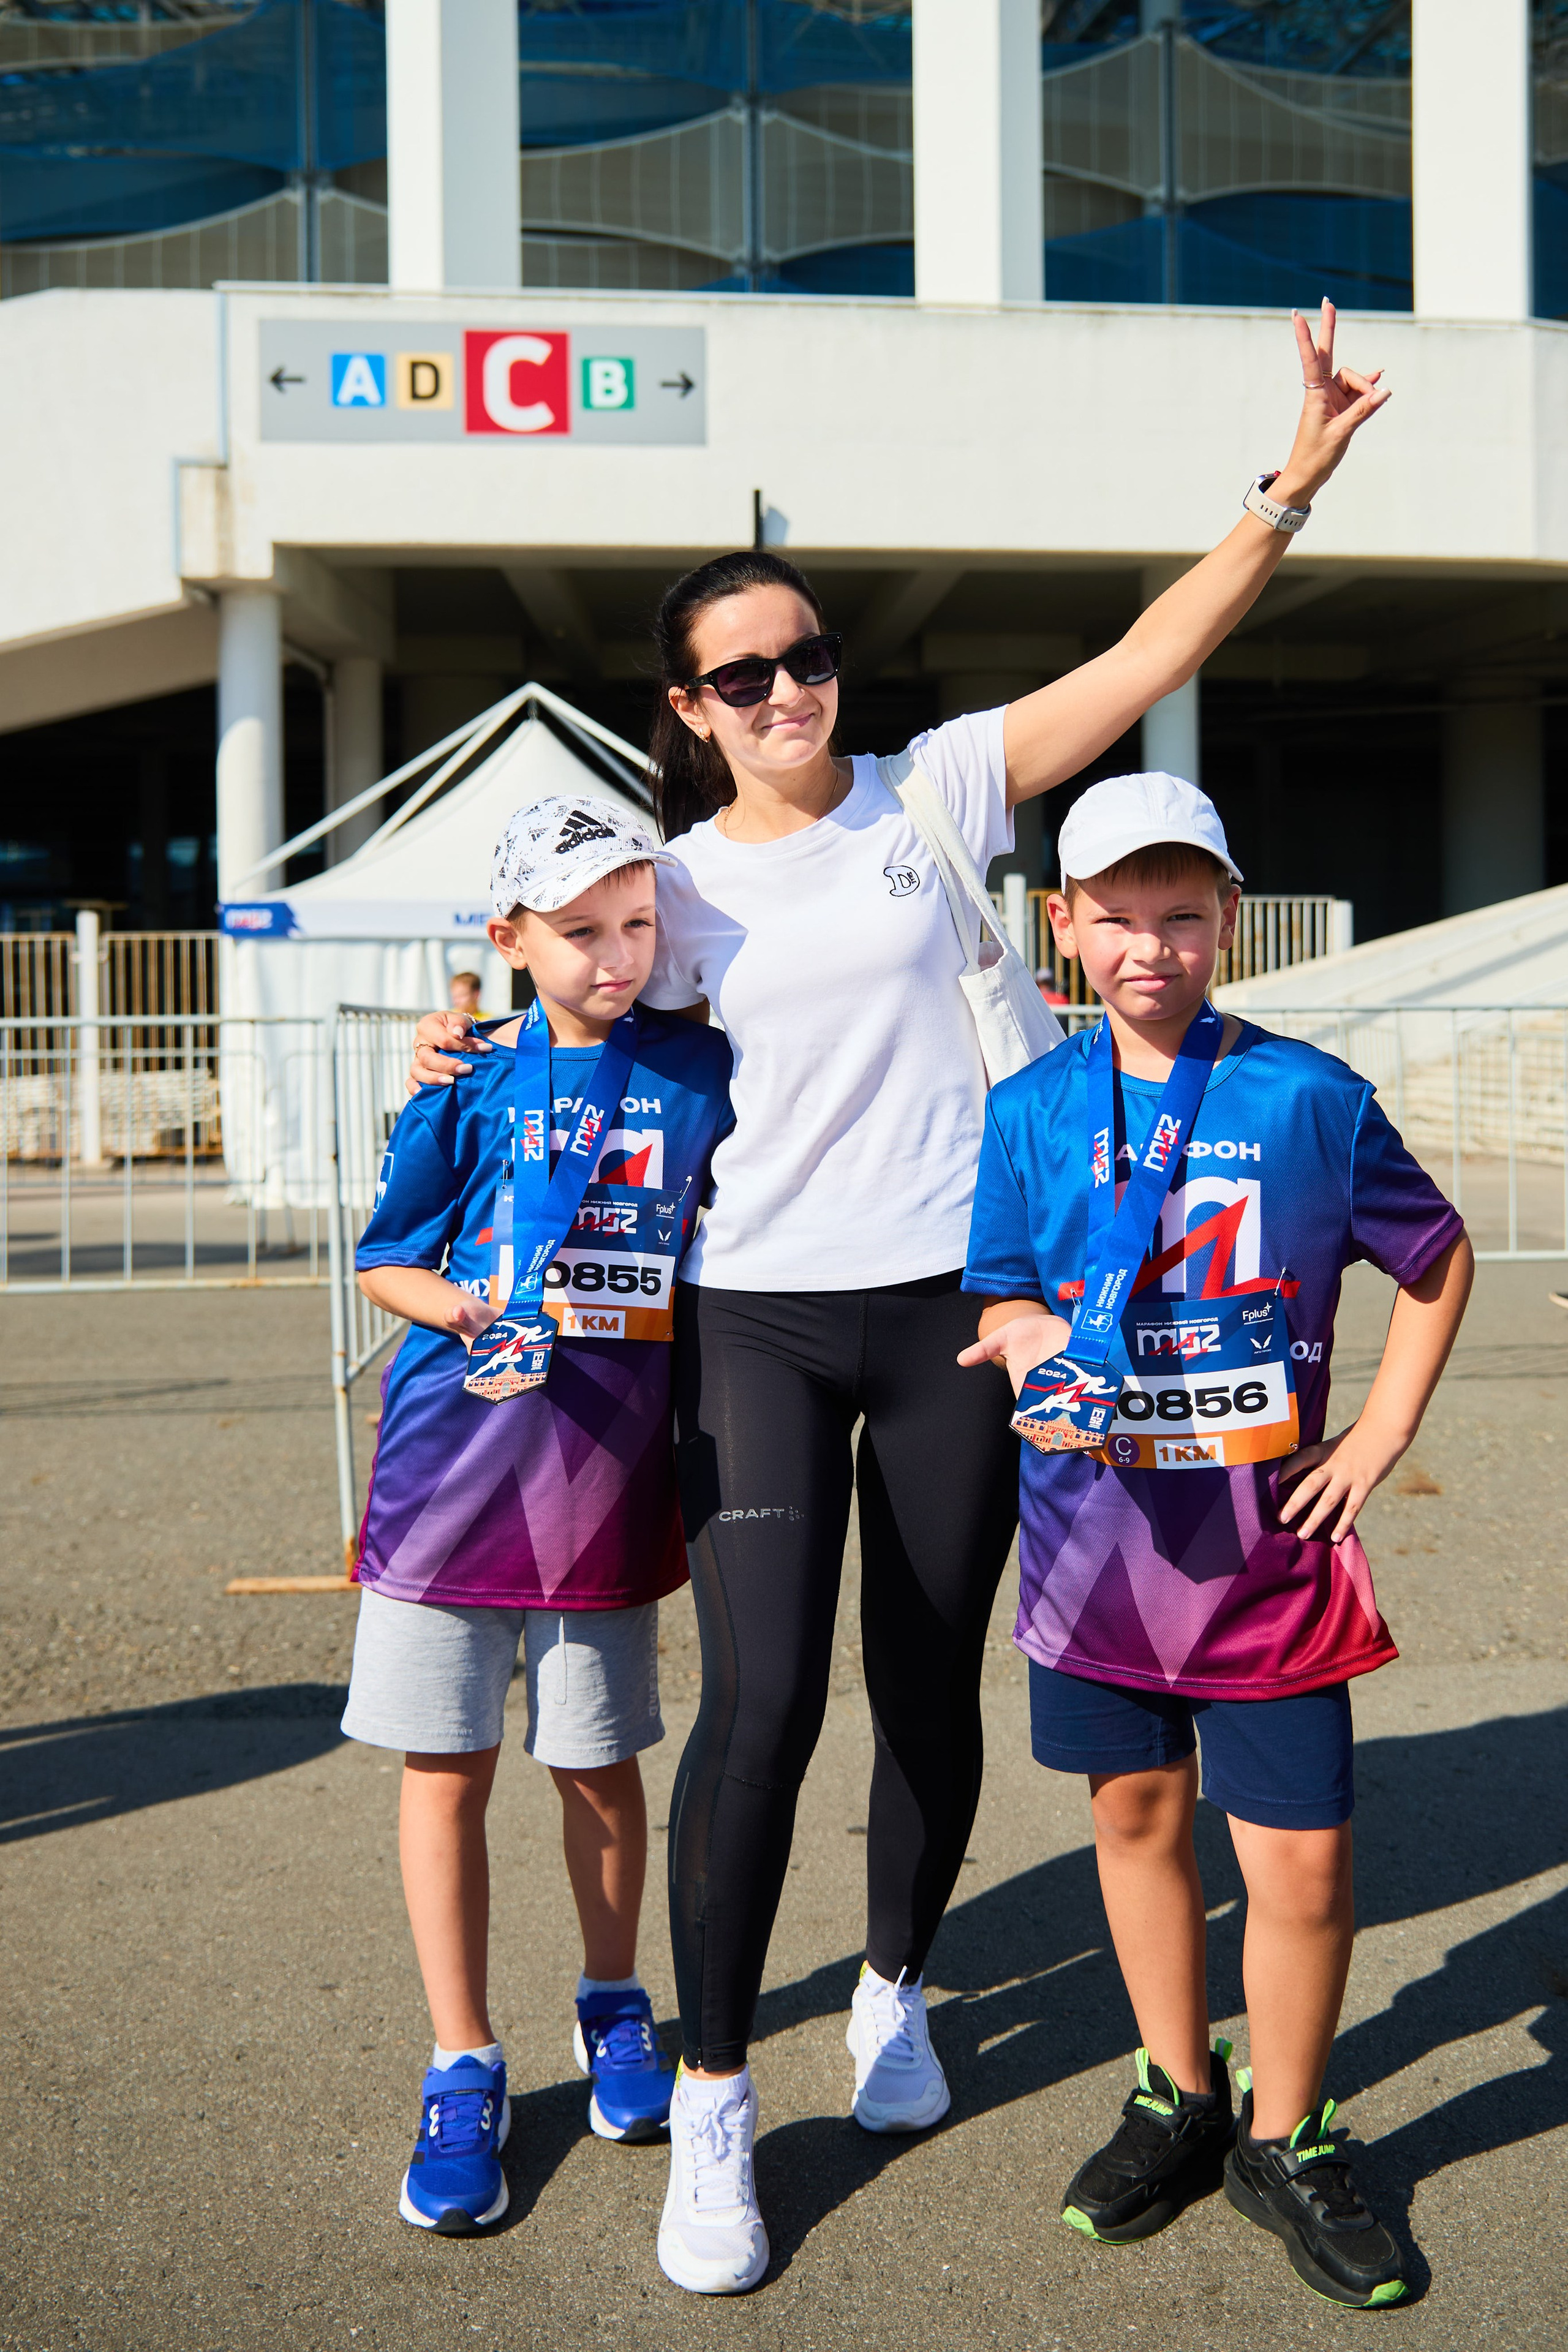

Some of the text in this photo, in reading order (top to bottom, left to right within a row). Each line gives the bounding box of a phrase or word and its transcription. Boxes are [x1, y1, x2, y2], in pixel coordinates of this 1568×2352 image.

[336, 334, 628, 432] A D C B
[556, 827, 616, 854] adidas
[533, 1239, 556, 1271] НОВГОРОД
[1096, 1272, 1115, 1308] НИЖНИЙ
[1105, 1268, 1128, 1310] НОВГОРОД
[567, 1315, 576, 1329] 1
[1038, 1368, 1067, 1379] 2024
[1113, 1381, 1269, 1422] 0856
[1159, 1446, 1169, 1462] 1
[718, 1508, 785, 1522] CRAFT
[1134, 2095, 1174, 2116] TIME JUMP
[1296, 2144, 1335, 2163] TIME JUMP
